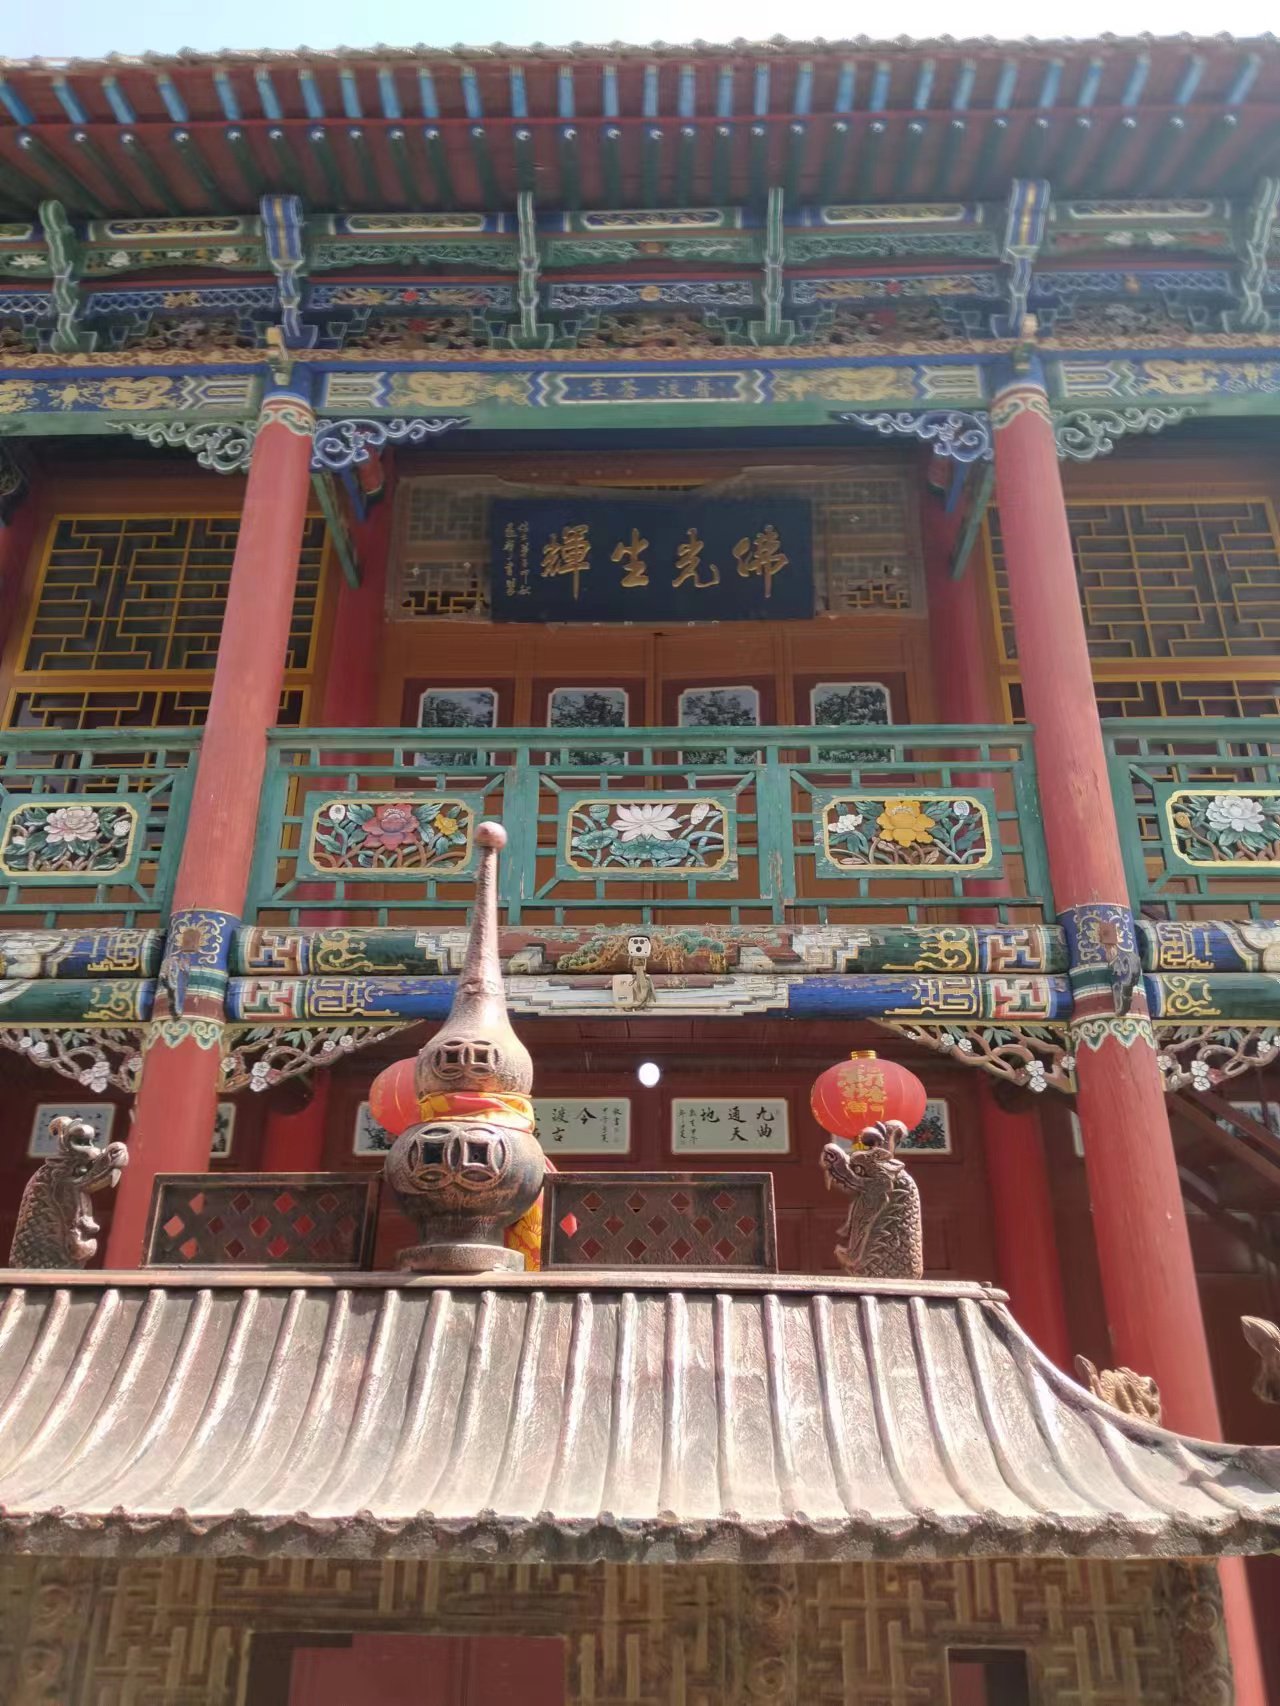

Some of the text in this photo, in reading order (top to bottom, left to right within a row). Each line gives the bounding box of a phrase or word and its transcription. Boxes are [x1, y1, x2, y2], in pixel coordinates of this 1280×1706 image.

[540, 522, 790, 600] 佛光生輝
[573, 1106, 597, 1125] 今
[700, 1106, 721, 1123] 地
[727, 1106, 749, 1142] 通天
[756, 1106, 775, 1138] 九曲
